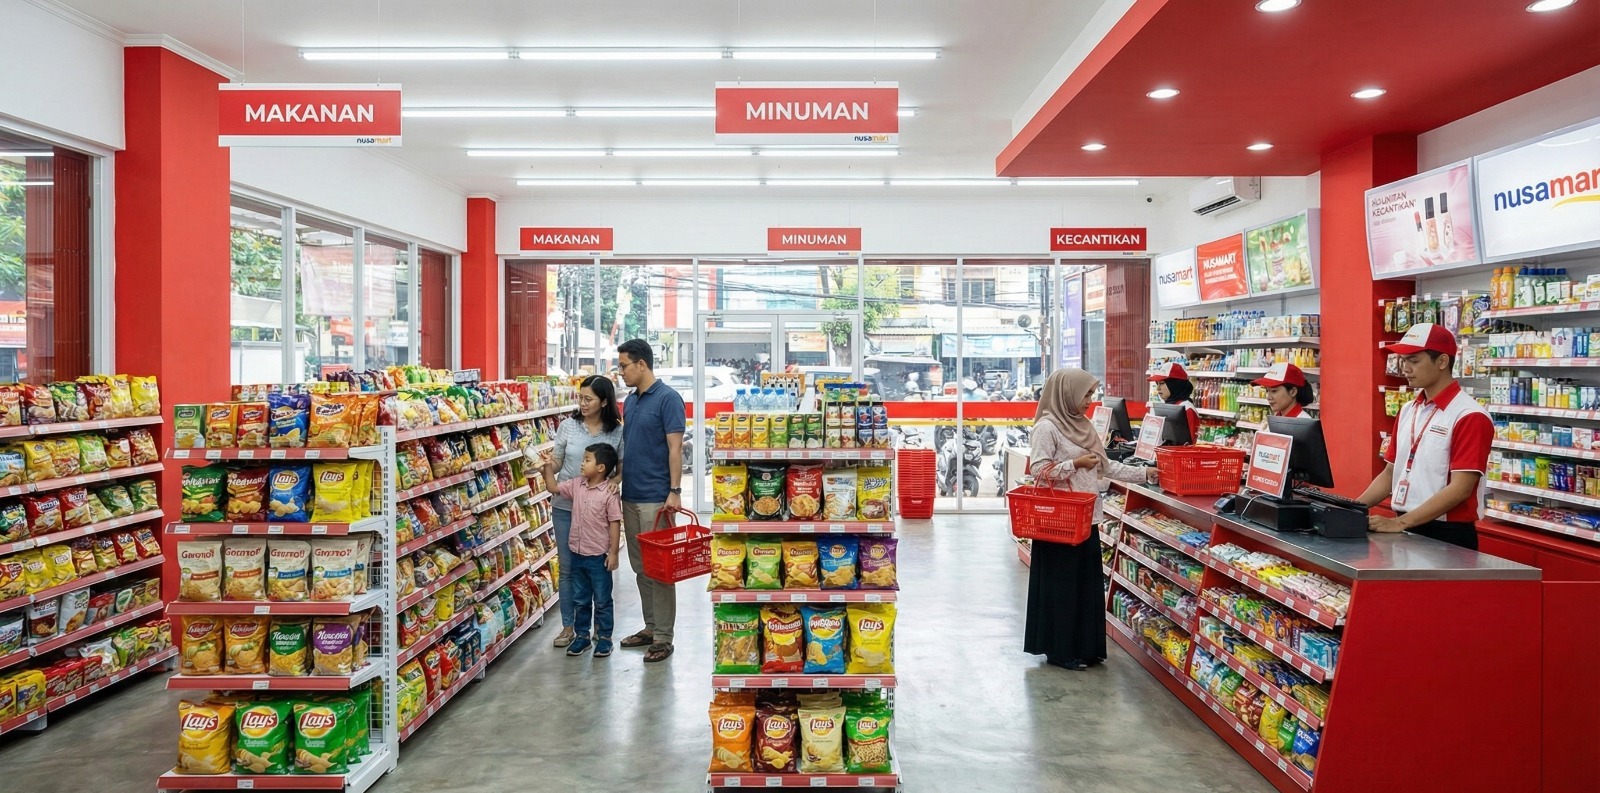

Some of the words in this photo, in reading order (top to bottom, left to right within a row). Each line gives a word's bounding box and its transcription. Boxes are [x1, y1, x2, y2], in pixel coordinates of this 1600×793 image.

[245, 104, 374, 122] MAKANAN
[746, 102, 869, 120] MINUMAN
[533, 234, 600, 245] MAKANAN
[782, 234, 847, 245] MINUMAN
[1056, 234, 1140, 245] KECANTIKAN
[1159, 266, 1193, 285] nusamart
